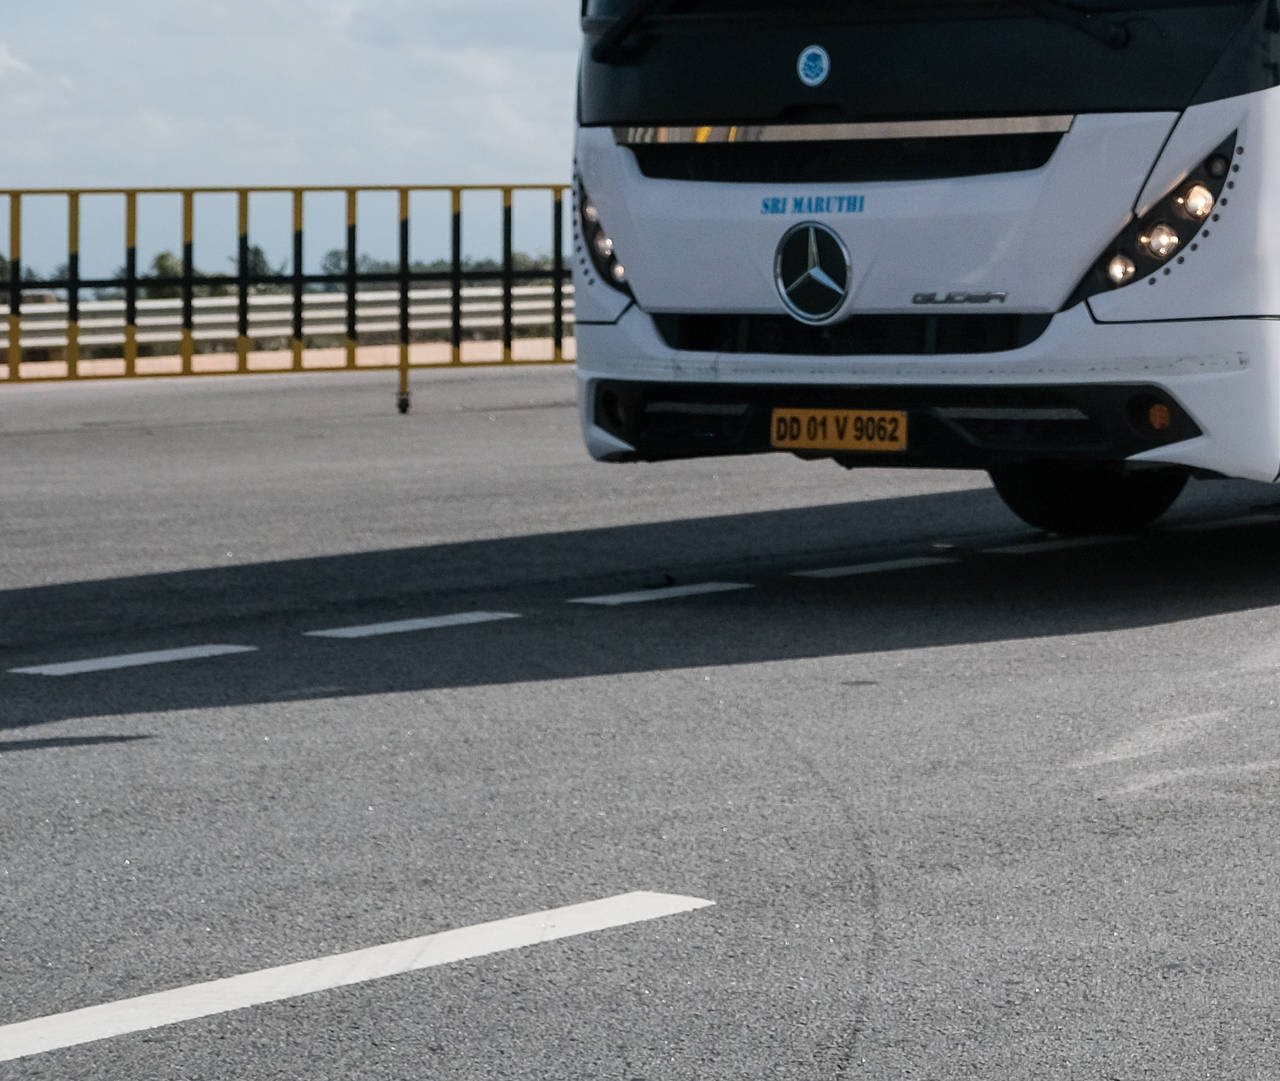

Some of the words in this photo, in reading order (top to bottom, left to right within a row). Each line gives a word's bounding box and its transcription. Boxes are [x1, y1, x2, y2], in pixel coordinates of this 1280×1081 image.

[760, 196, 788, 215] SRI
[790, 195, 866, 214] MARUTHI
[775, 415, 800, 441] DD
[806, 415, 828, 441] 01
[835, 415, 850, 441] V
[853, 415, 900, 442] 9062
